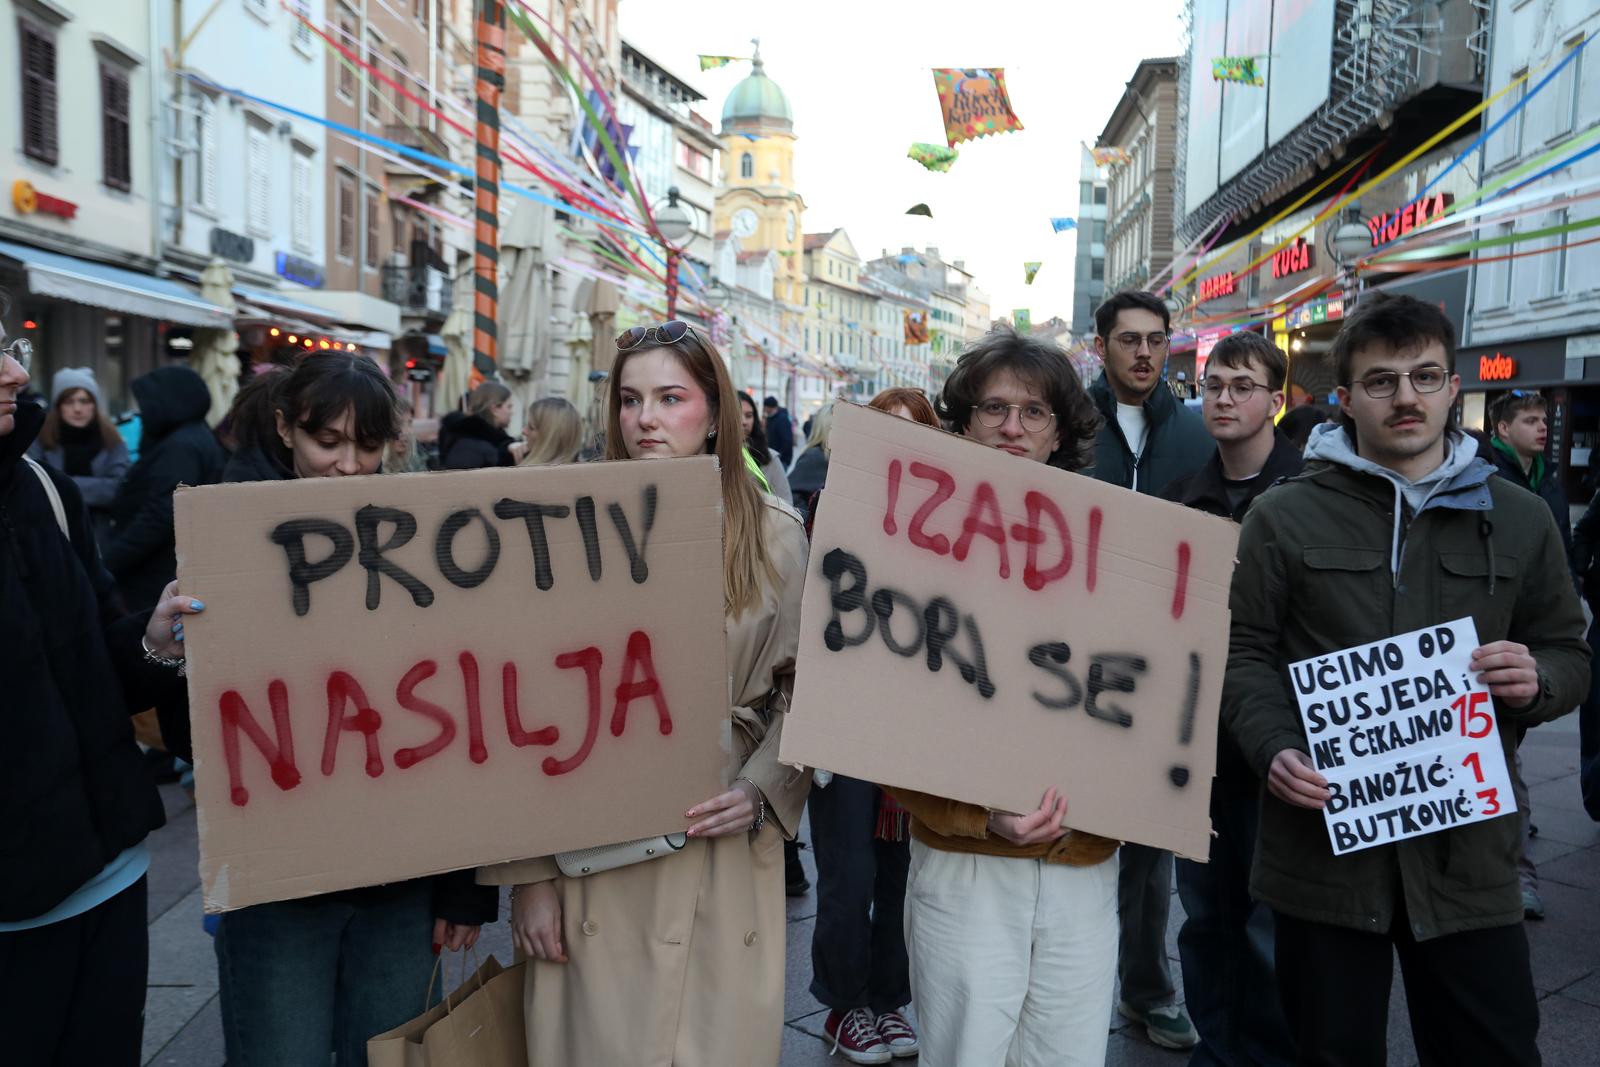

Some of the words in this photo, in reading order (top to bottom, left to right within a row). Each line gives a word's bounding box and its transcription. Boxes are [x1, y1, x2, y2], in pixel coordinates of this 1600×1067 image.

[1272, 236, 1309, 278] KUĆA
[1480, 352, 1512, 381] Rodea
[267, 484, 659, 616] PROTIV
[883, 459, 1103, 592] IZAĐI
[822, 548, 996, 699] BORI
[1293, 642, 1404, 695] UČIMO
[1418, 627, 1455, 658] OD
[218, 631, 673, 806] NASILJA
[1307, 669, 1455, 733] SUSJEDA
[1313, 737, 1345, 770] NE
[1349, 708, 1453, 757] ČEKAJMO
[1451, 692, 1493, 738] 15
[1325, 755, 1454, 814] BANOŽIĆ:
[1462, 752, 1485, 783] 1
[1332, 789, 1473, 851] BUTKOVIĆ:
[1476, 788, 1500, 815] 3
